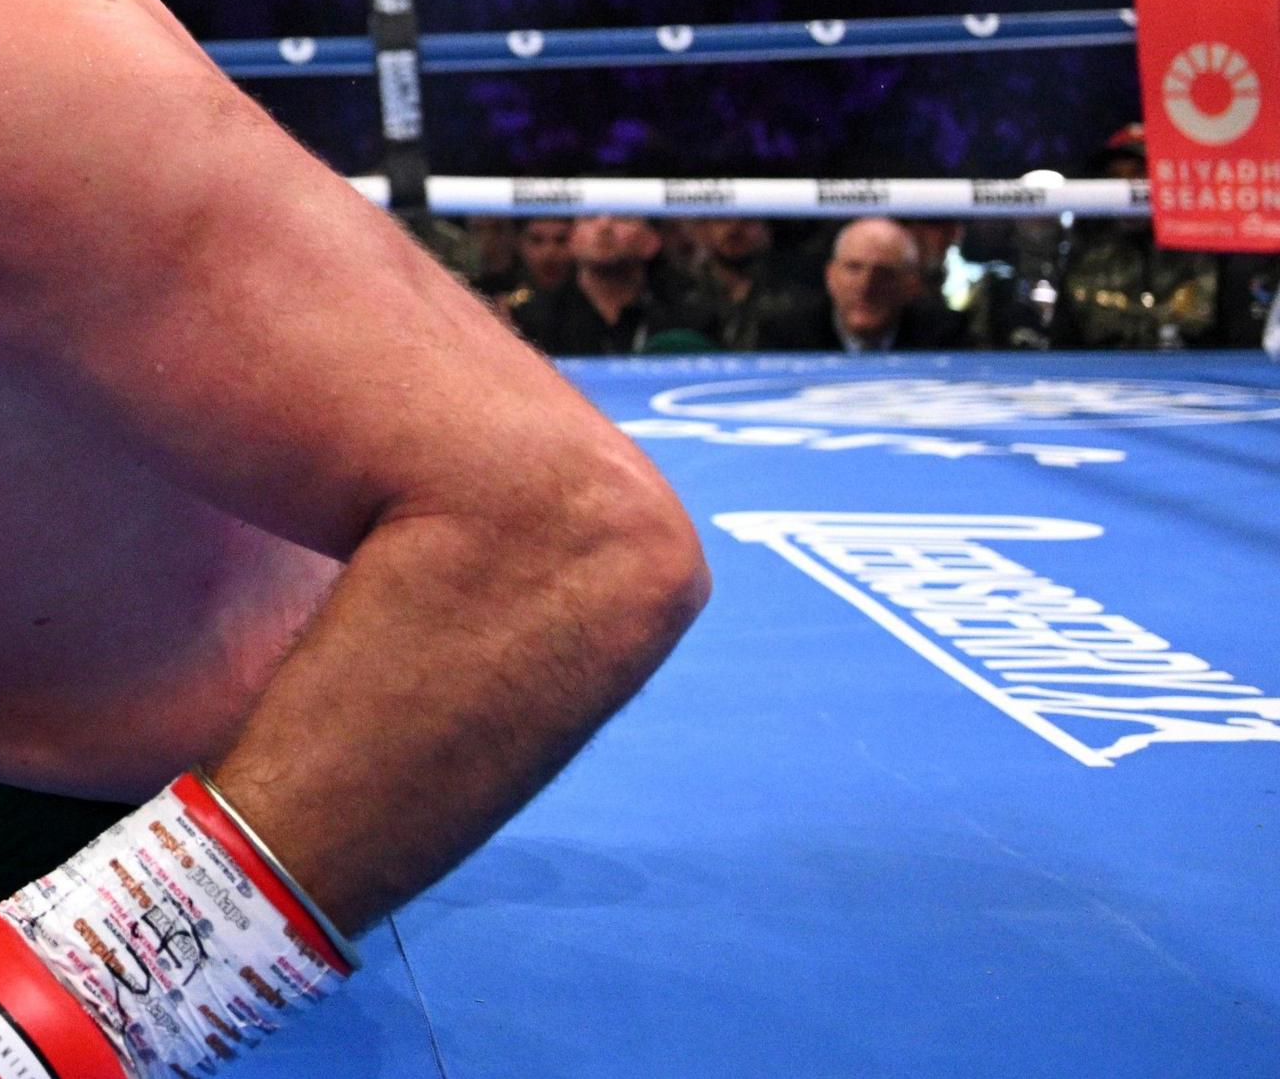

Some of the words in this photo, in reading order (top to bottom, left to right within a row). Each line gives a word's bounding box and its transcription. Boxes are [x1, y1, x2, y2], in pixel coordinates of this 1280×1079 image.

[1157, 158, 1280, 183] RIYADH
[1159, 185, 1280, 212] SEASON
[187, 863, 252, 934] protape
